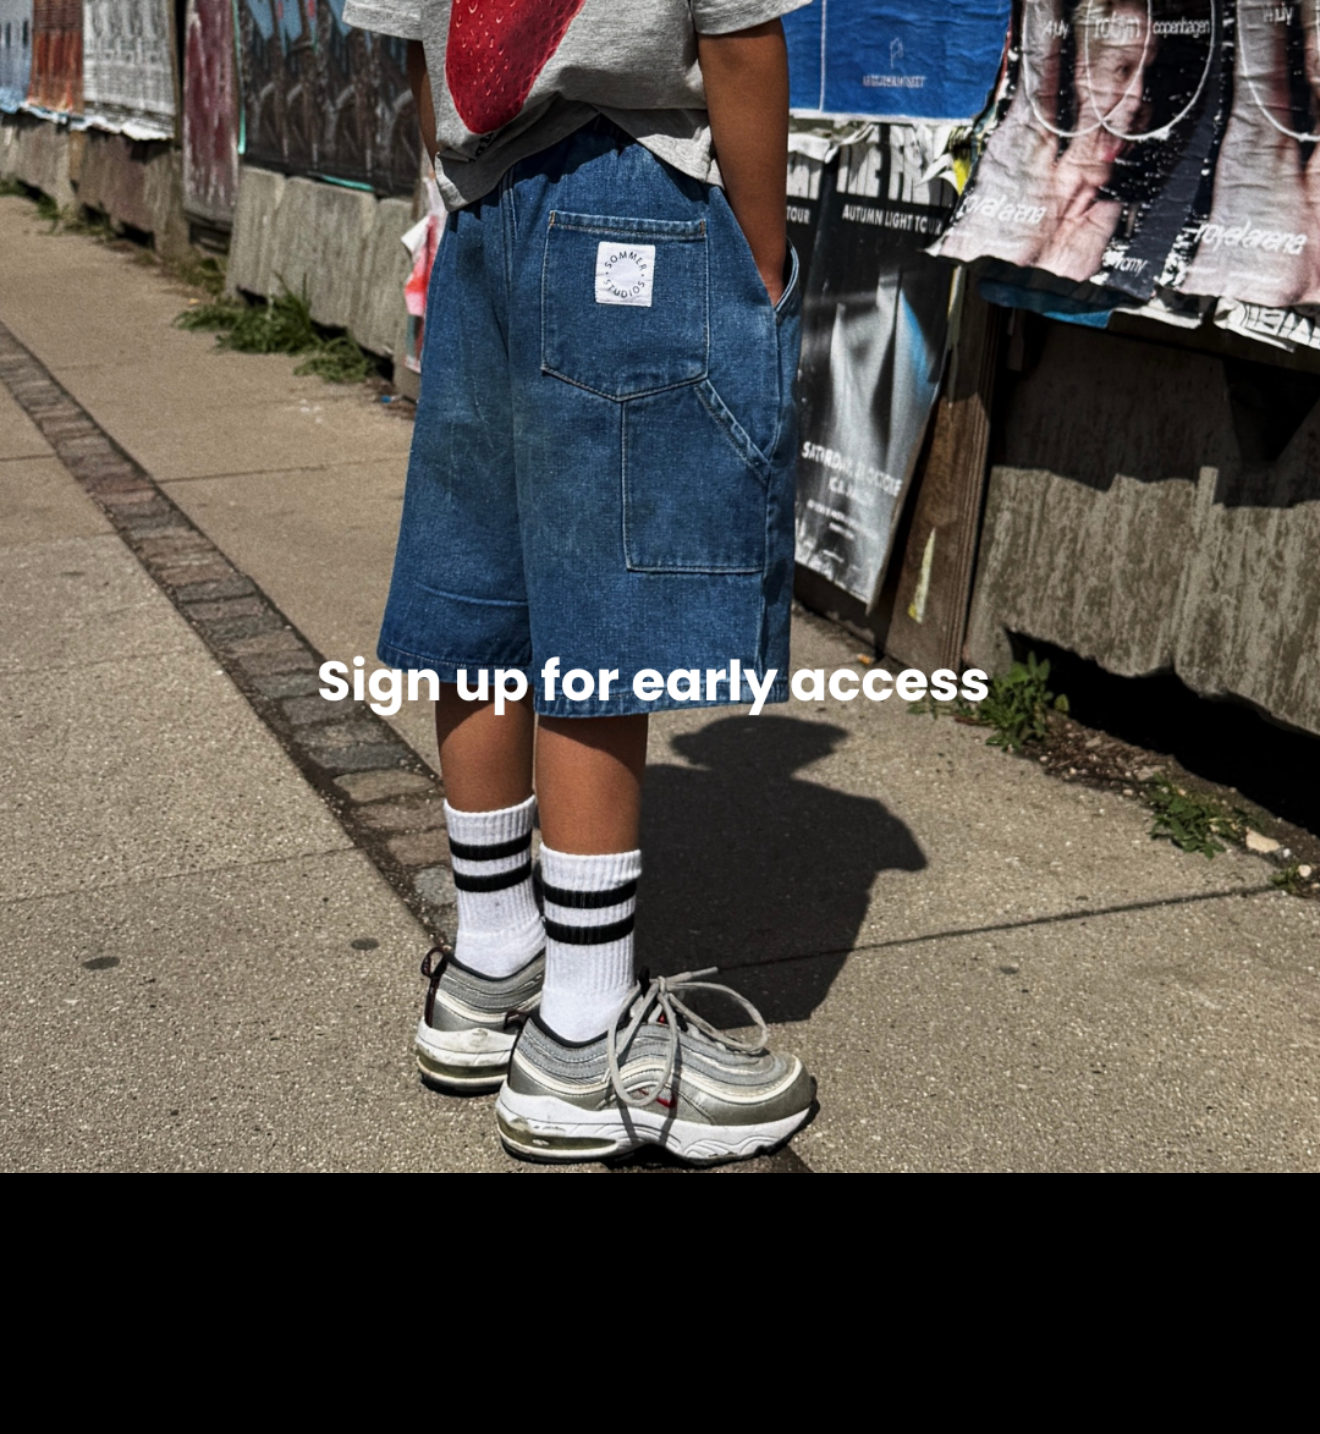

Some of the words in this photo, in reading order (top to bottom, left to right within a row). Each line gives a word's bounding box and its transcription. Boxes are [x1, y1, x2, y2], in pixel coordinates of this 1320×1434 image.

[1152, 16, 1211, 38] copenhagen
[842, 204, 882, 226] AUTUMN
[884, 212, 912, 230] LIGHT
[604, 250, 648, 271] SOMMER
[603, 279, 646, 299] STUDIOS
